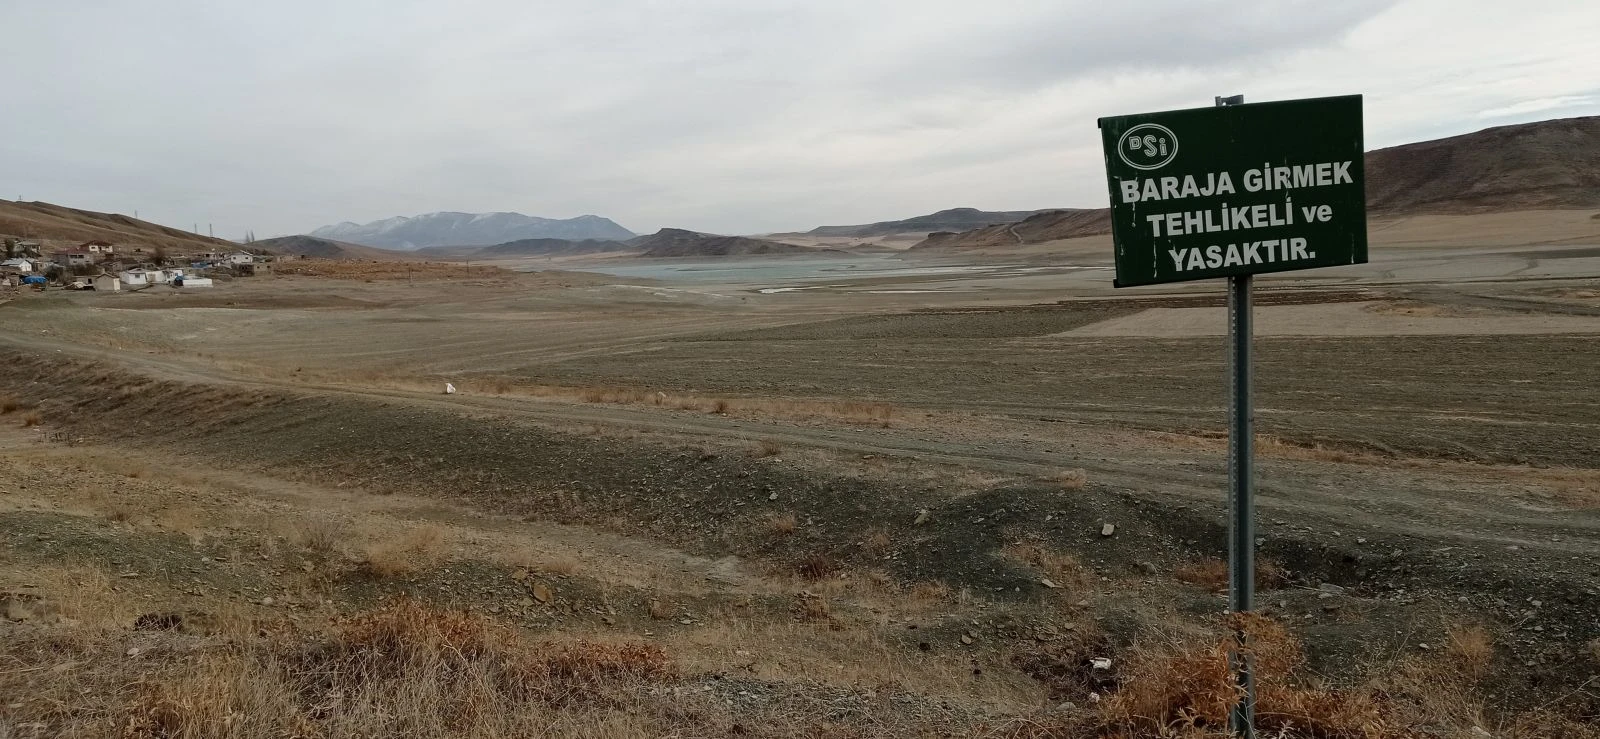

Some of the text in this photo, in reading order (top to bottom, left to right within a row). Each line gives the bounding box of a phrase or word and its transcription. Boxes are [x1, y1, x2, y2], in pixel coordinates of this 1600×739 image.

[1120, 161, 1353, 204] BARAJA GİRMEK
[1146, 197, 1333, 238] TEHLİKELİ ve
[1168, 237, 1316, 272] YASAKTIR.
